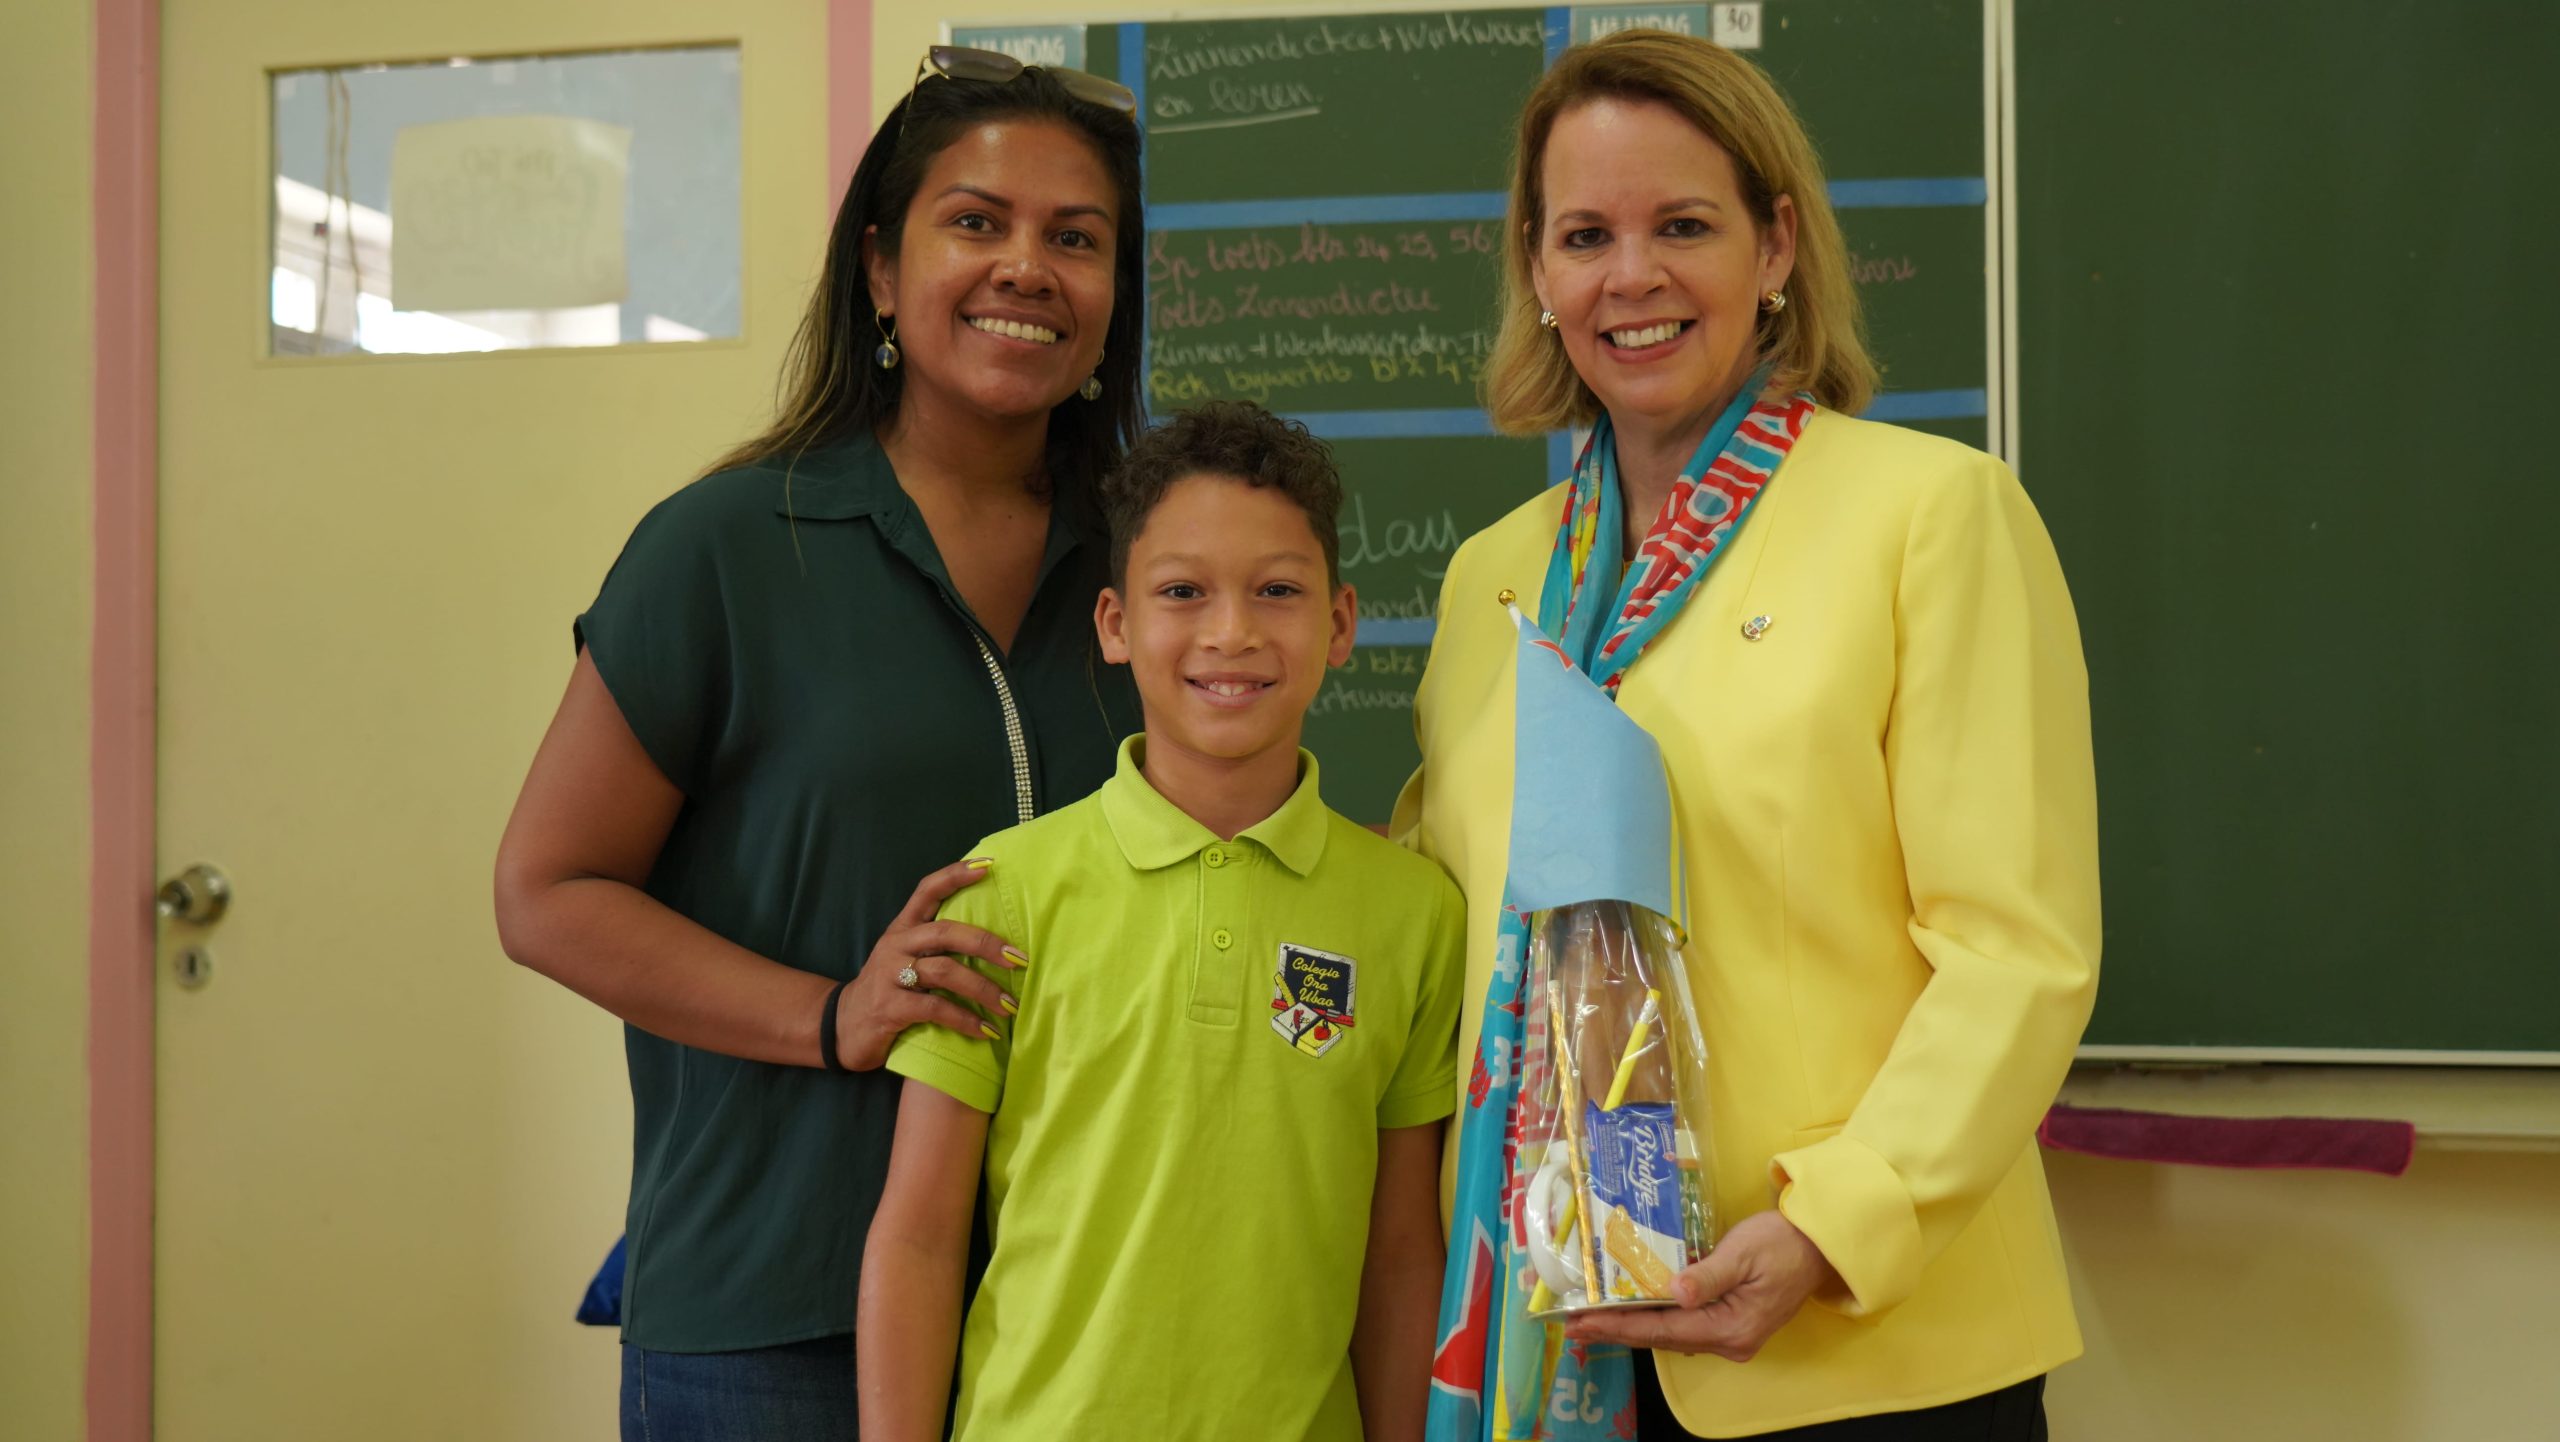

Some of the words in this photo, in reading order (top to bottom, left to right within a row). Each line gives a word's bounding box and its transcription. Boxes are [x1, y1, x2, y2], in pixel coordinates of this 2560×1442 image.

[1292, 957, 1340, 979] Colegio
[1299, 988, 1335, 1007] Ubao
[1628, 1125, 1658, 1207] Bridge
